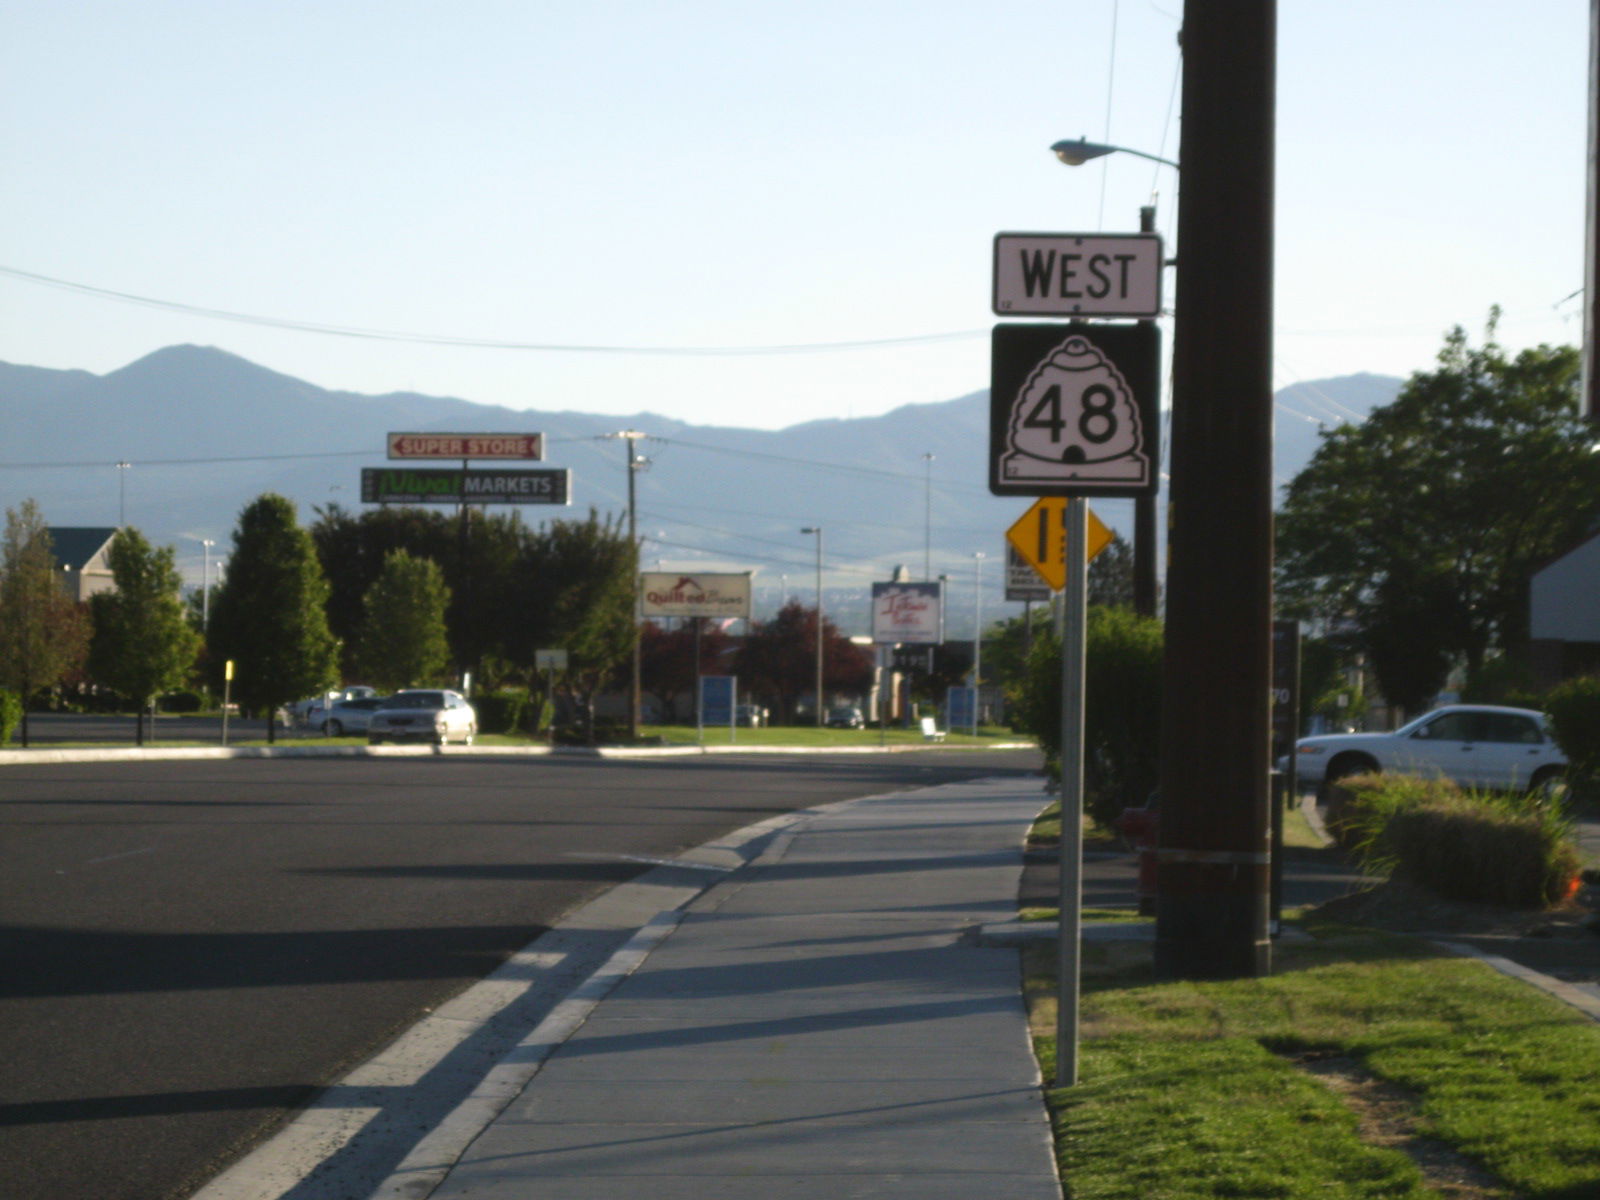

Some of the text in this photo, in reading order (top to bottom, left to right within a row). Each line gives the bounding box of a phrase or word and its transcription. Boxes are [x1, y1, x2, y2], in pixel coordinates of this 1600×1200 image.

[1020, 249, 1136, 299] WEST
[1023, 383, 1118, 444] 48
[402, 439, 528, 455] SUPER STORE
[464, 477, 550, 493] MARKETS
